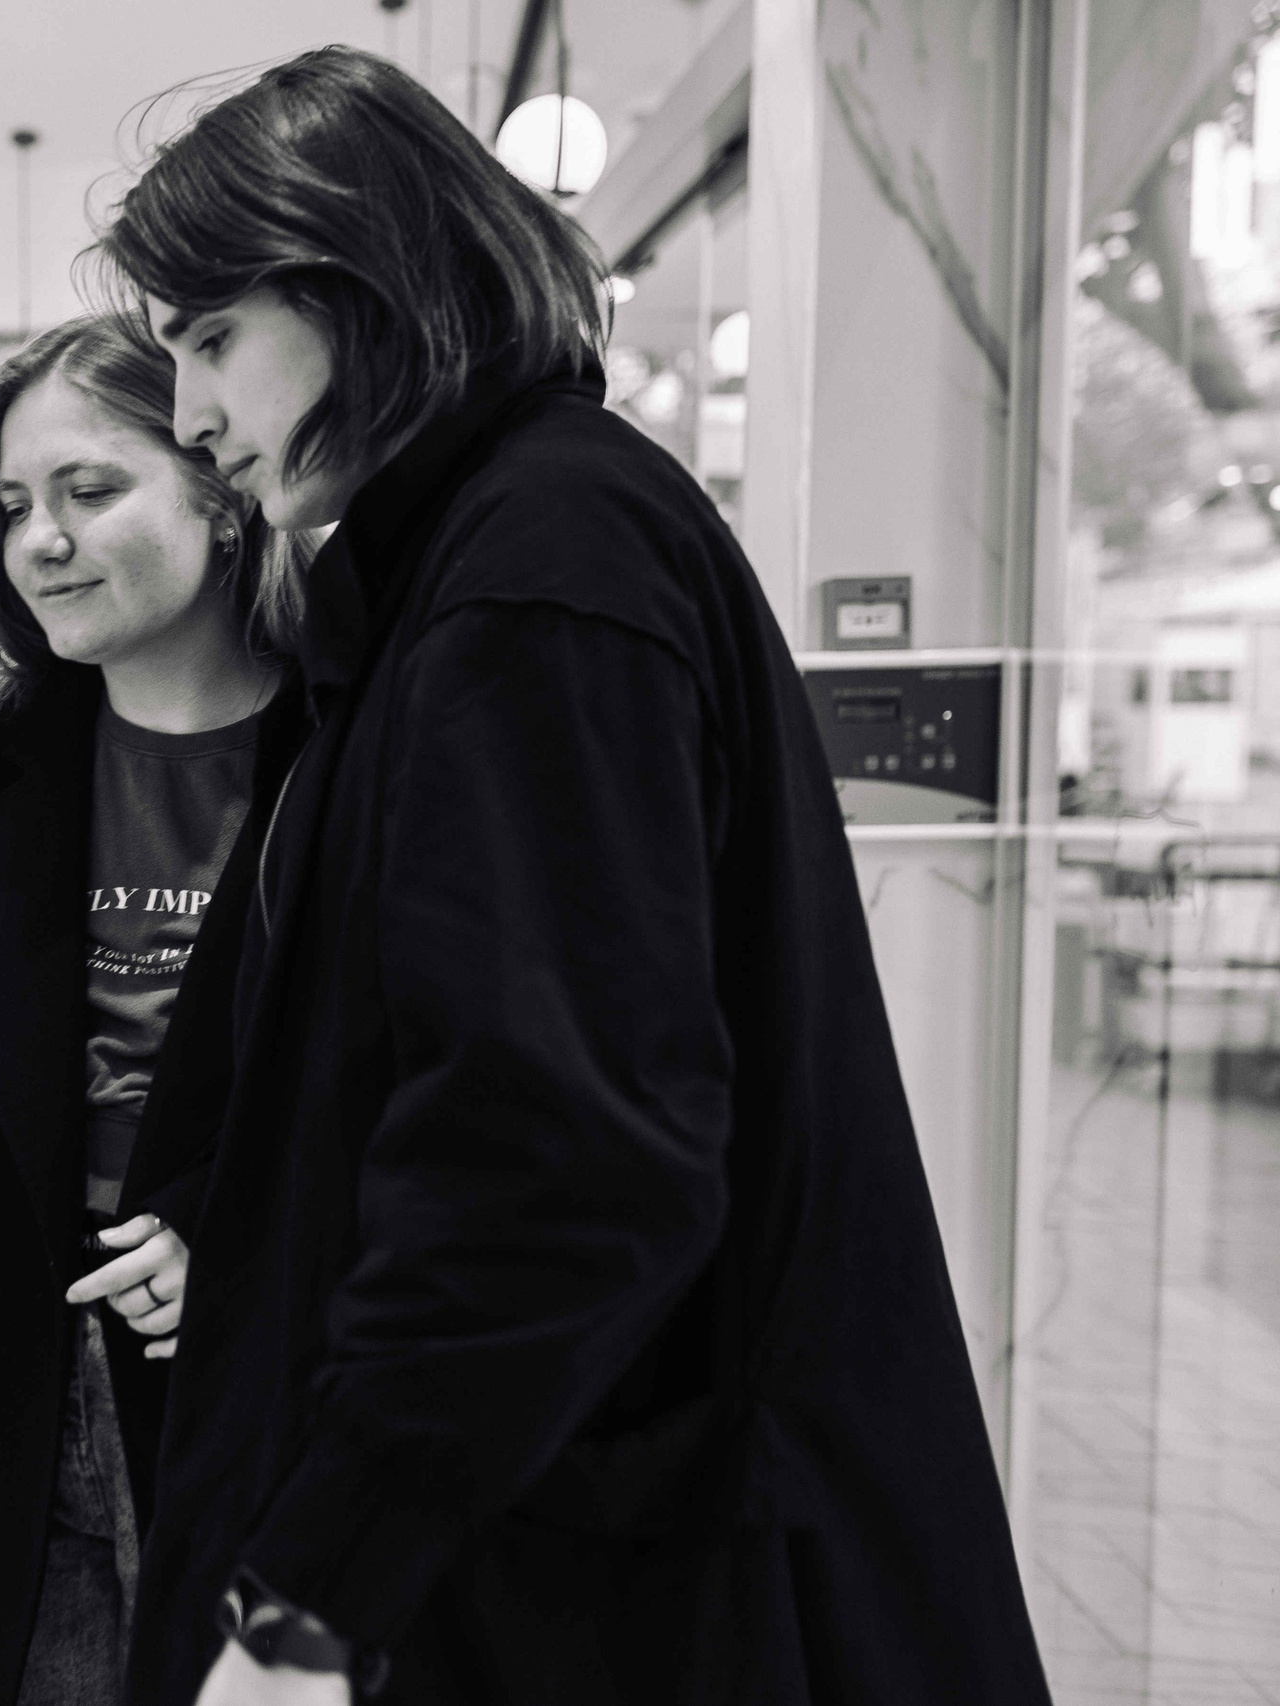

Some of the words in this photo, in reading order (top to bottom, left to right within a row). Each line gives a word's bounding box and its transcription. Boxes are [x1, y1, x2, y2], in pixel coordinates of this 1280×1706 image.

[86, 886, 140, 912] LY
[142, 888, 212, 915] IMP
[86, 959, 131, 975] THINK
